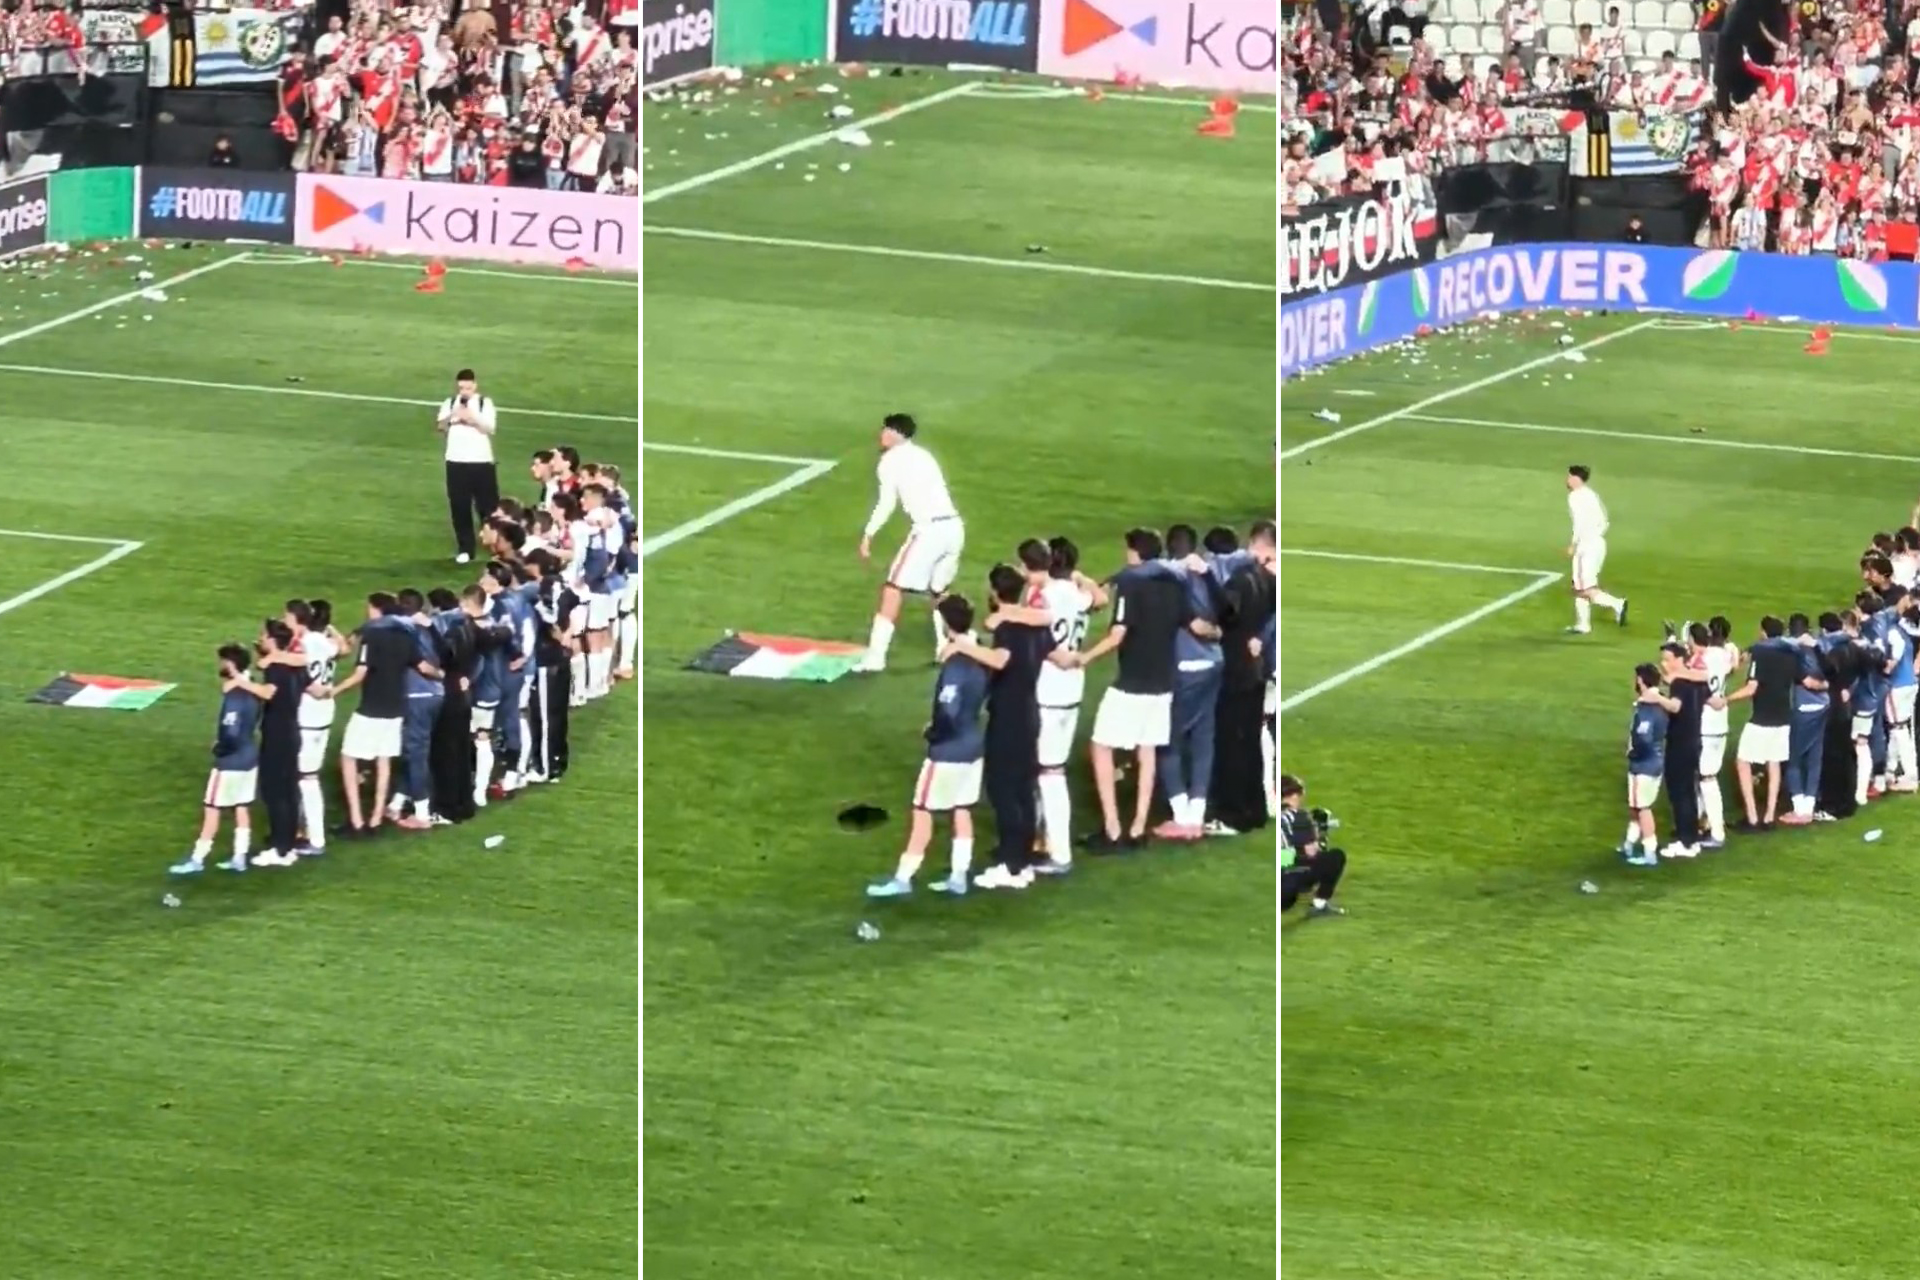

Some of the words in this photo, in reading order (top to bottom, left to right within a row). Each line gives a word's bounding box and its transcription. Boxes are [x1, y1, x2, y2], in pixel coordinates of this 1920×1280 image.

[850, 0, 1028, 46] #FOOTBALL
[1185, 3, 1276, 72] ka
[150, 186, 286, 224] #FOOTBALL
[406, 191, 624, 255] kaizen
[1438, 250, 1648, 319] RECOVER
